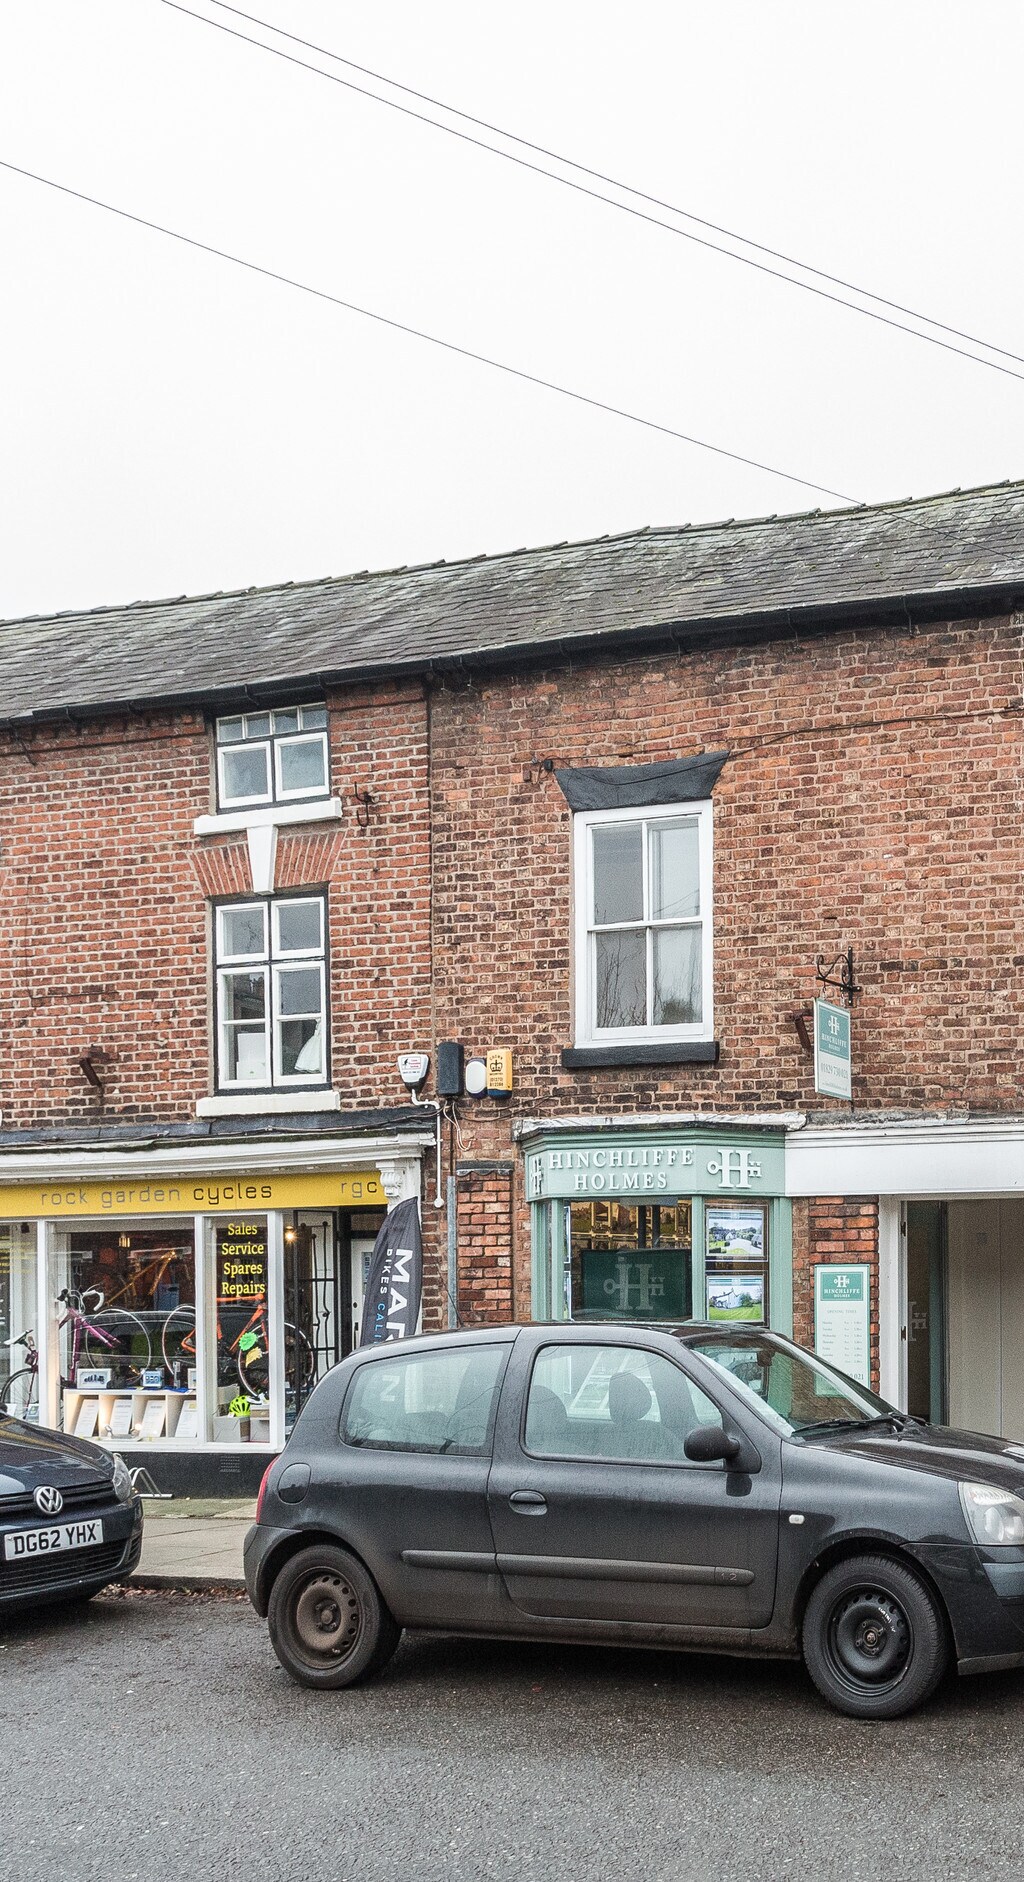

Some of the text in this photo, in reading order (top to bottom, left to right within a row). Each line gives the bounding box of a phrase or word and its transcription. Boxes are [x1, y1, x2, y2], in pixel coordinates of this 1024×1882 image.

[549, 1149, 694, 1169] HINCHLIFFE
[341, 1181, 378, 1198] rgc
[574, 1172, 667, 1190] HOLMES
[41, 1182, 272, 1208] rock garden cycles
[227, 1222, 258, 1236] Sales
[221, 1242, 265, 1255] Service
[223, 1262, 263, 1279] Spares
[221, 1281, 266, 1297] Repairs
[374, 1303, 385, 1344] CALI
[13, 1523, 97, 1555] DG62 YHX
